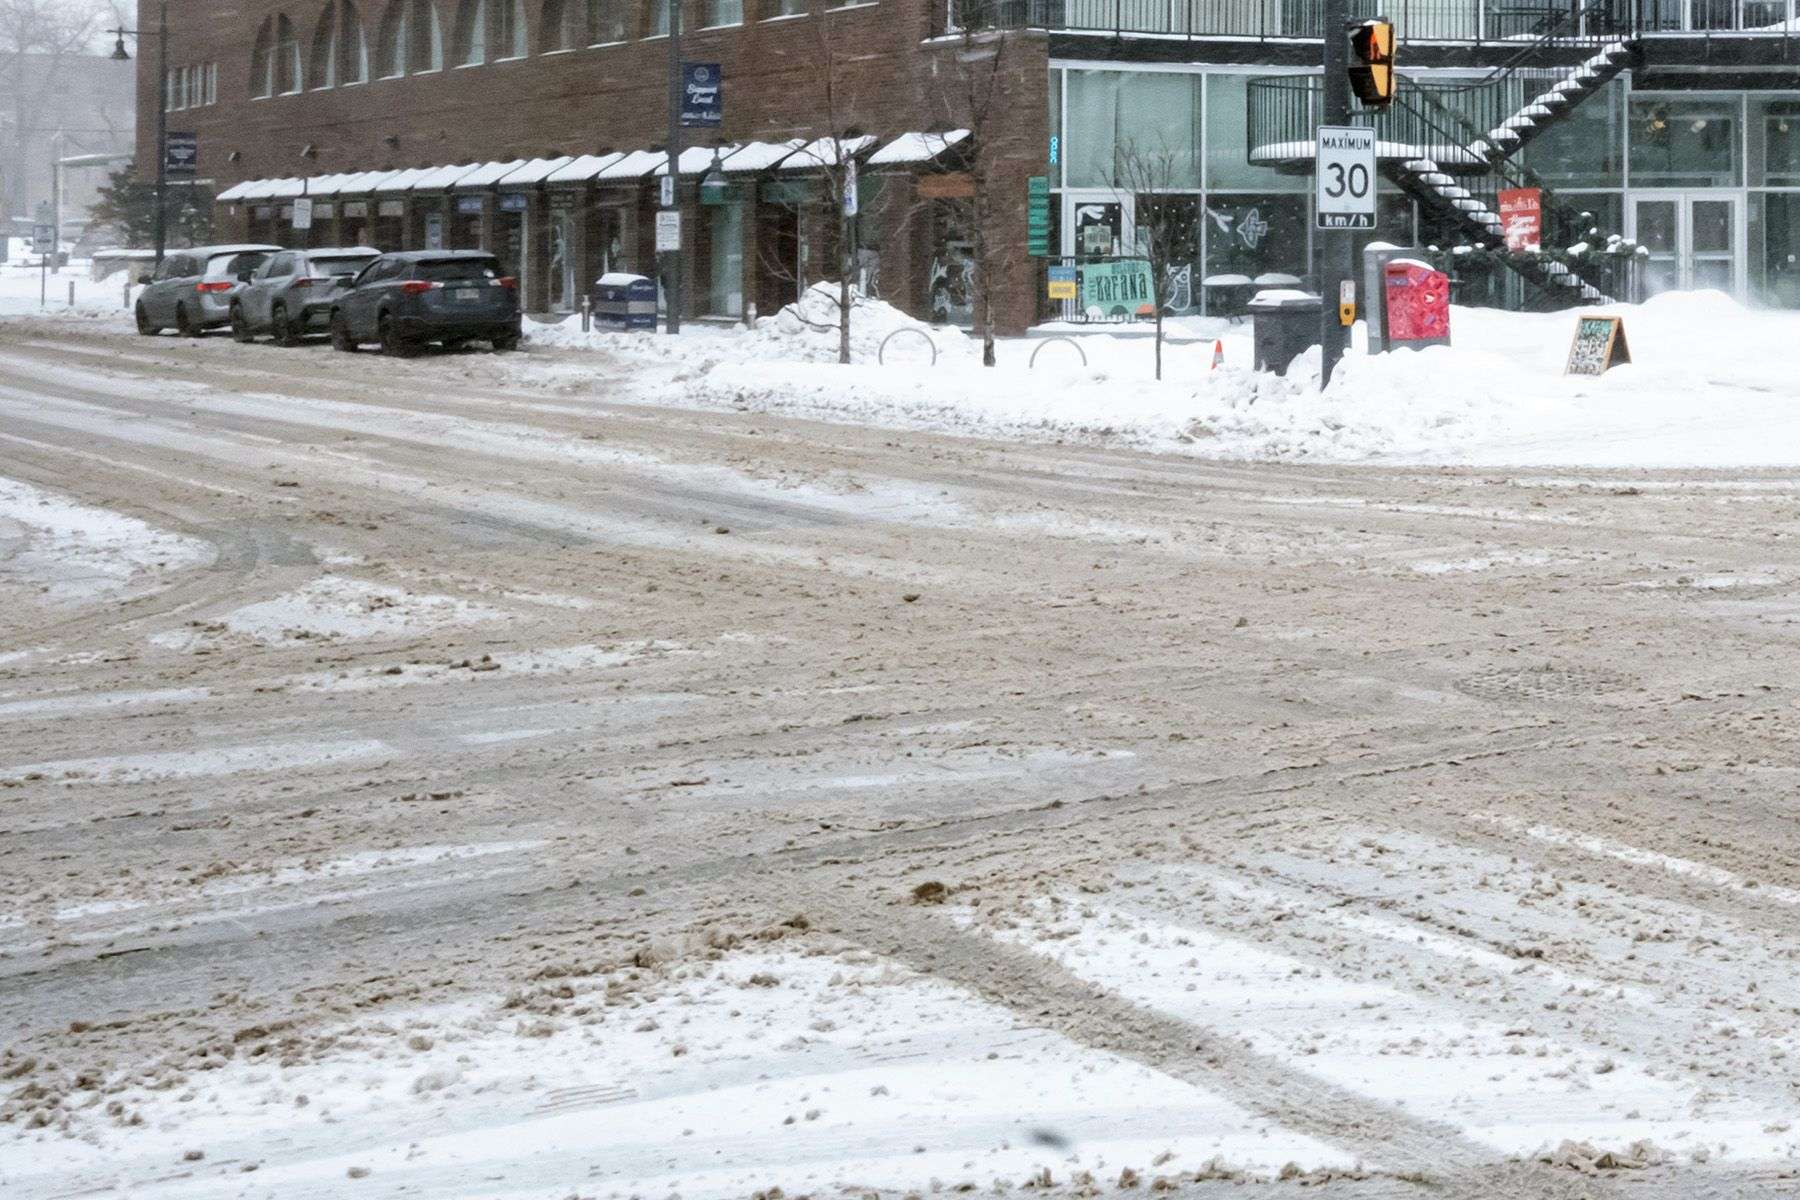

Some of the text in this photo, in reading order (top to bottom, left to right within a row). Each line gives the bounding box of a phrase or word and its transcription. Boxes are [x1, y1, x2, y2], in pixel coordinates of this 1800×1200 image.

[1322, 137, 1371, 150] MAXIMUM
[1325, 162, 1369, 198] 30
[1325, 213, 1368, 227] km/h
